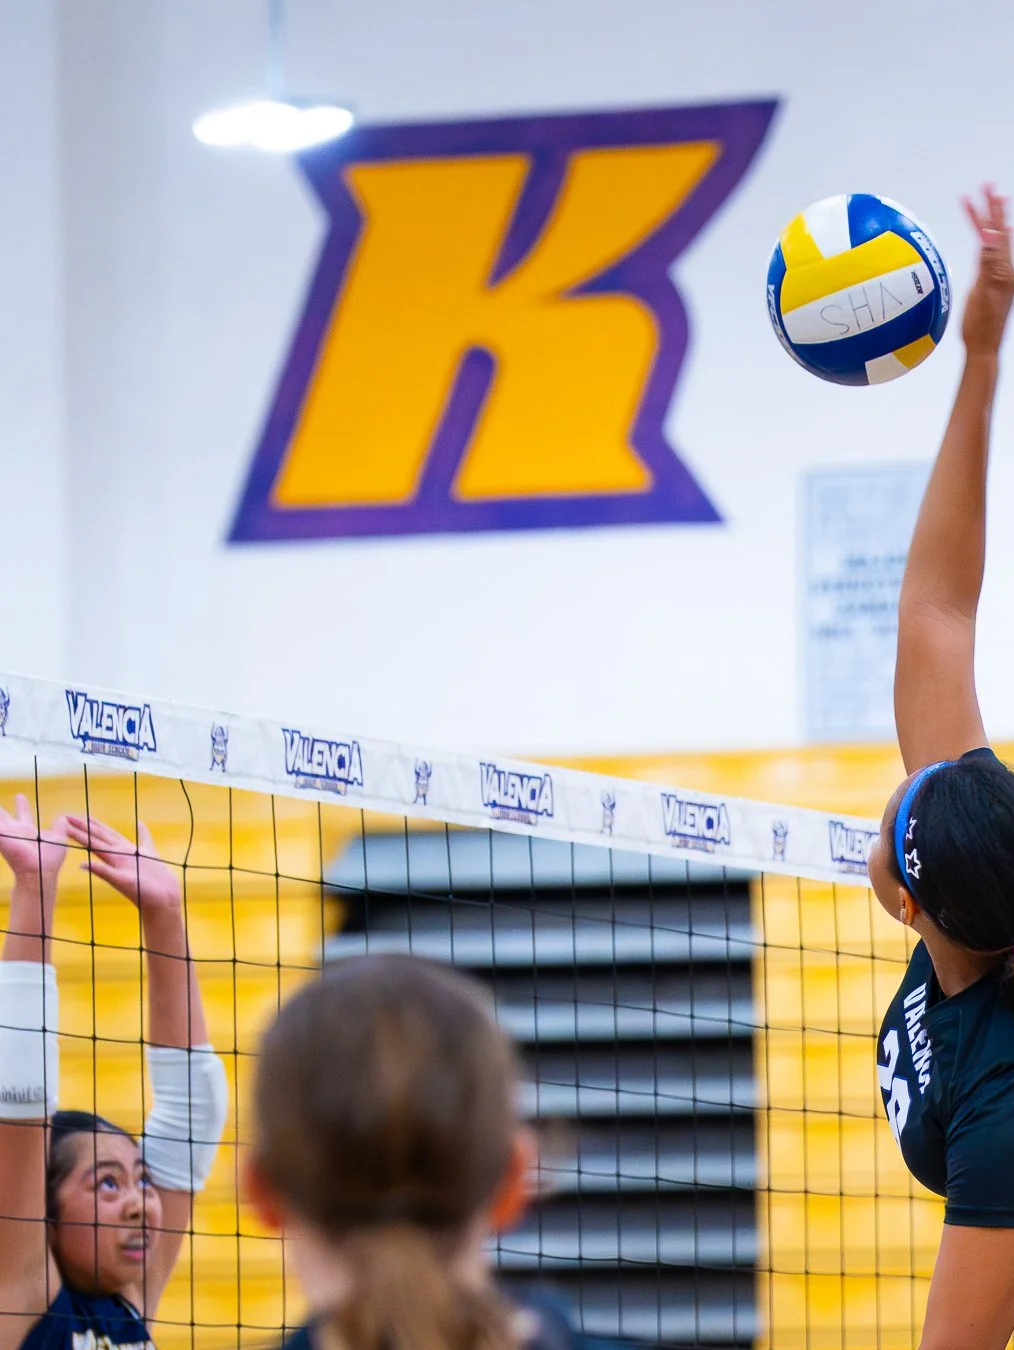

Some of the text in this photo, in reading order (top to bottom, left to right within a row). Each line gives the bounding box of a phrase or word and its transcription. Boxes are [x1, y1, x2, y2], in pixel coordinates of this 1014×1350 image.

[66, 689, 157, 752] VALENCIA
[281, 727, 364, 787] VALENCIA
[479, 762, 554, 817] VALENCIA
